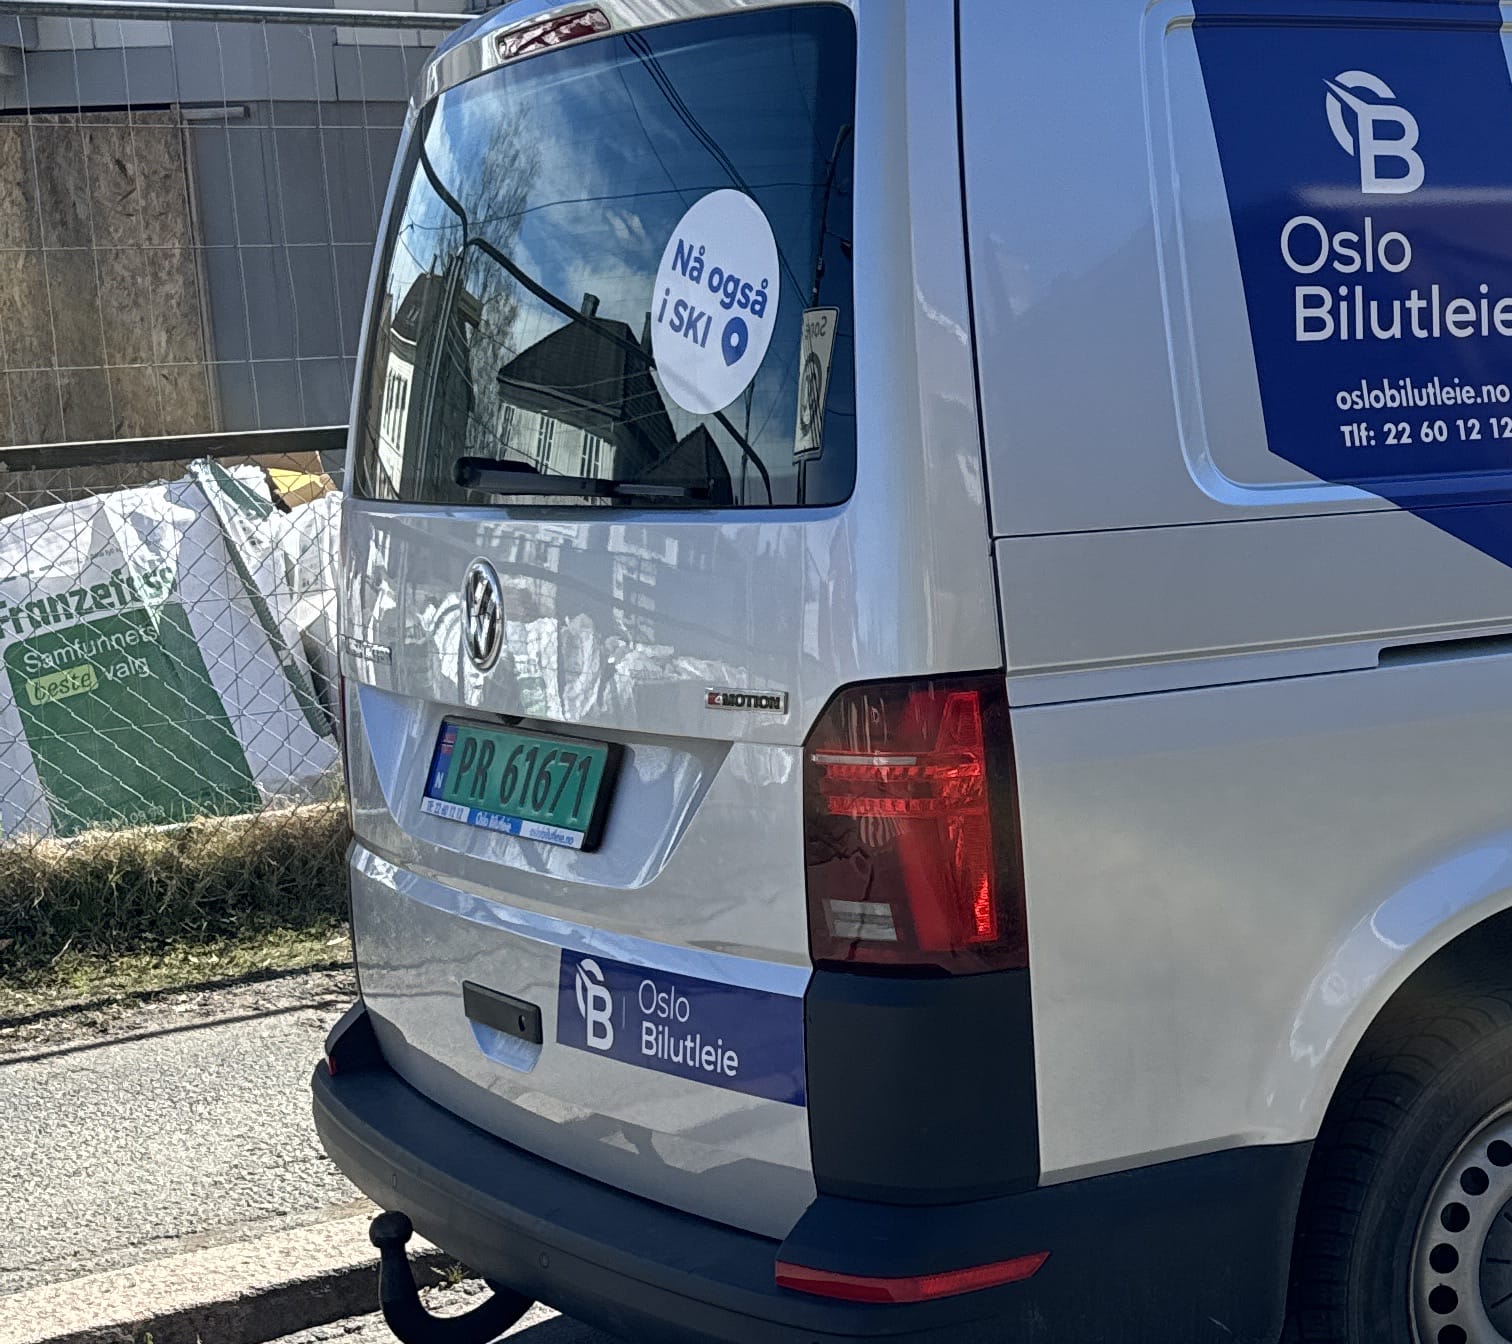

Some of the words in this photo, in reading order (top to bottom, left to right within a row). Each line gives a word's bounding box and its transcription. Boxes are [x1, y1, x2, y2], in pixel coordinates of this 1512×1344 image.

[1280, 215, 1412, 274] Oslo
[671, 238, 706, 285] Nå
[707, 266, 769, 319] også
[657, 287, 671, 324] i
[669, 298, 713, 349] SKI
[1336, 377, 1511, 410] oslobilutleie.no
[1340, 422, 1376, 447] Tlf:
[1383, 422, 1413, 445] 22
[1420, 420, 1448, 443] 60
[1455, 419, 1482, 441] 12
[23, 624, 158, 673] Samfunnets
[33, 672, 92, 701] beste
[104, 656, 150, 681] valg
[713, 692, 781, 710] 4MOTION
[434, 772, 445, 789] N
[453, 736, 496, 800] PR
[500, 744, 593, 819] 61671
[638, 979, 690, 1023] Oslo
[641, 1020, 739, 1077] Bilutleie
